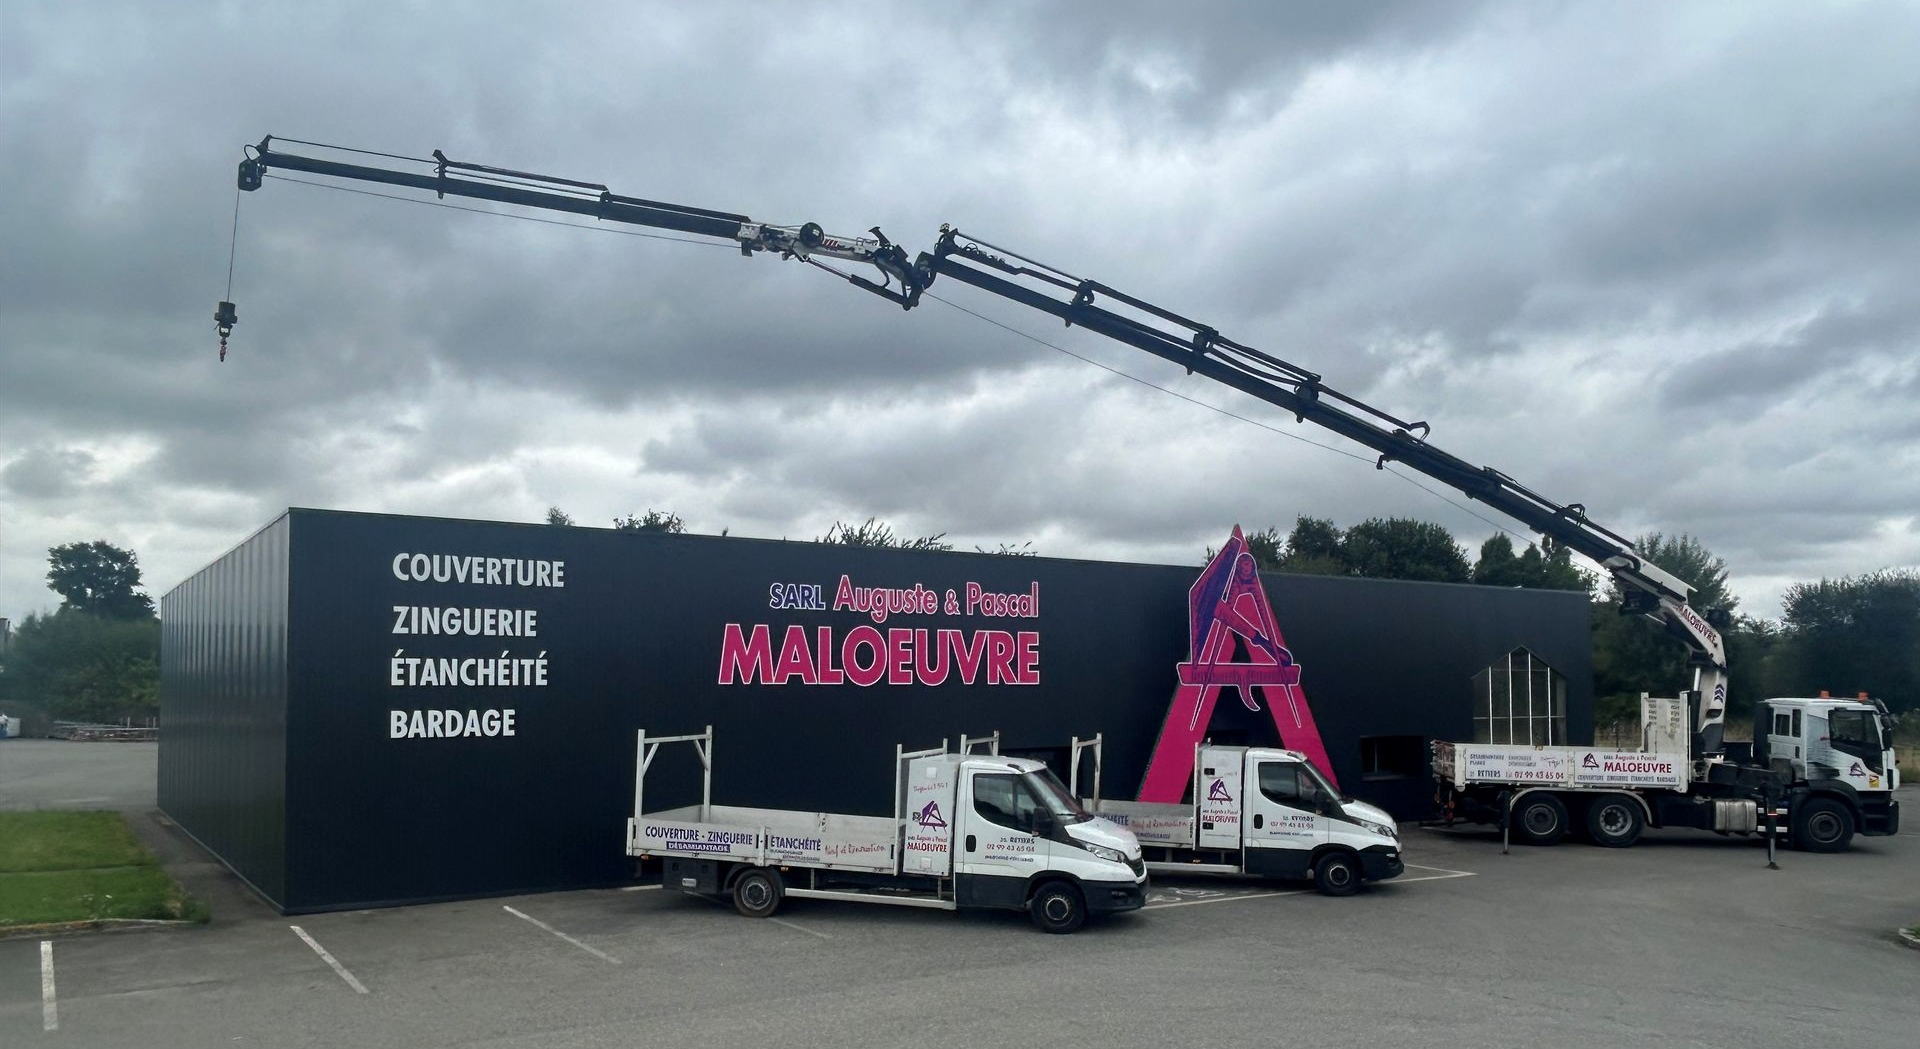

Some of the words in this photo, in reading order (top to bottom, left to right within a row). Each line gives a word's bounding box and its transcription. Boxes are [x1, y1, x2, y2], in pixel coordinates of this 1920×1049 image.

[392, 553, 564, 587] COUVERTURE
[769, 583, 825, 611] SARL
[833, 574, 937, 623] Auguste
[944, 589, 961, 615] &
[966, 581, 1039, 618] Pascal
[392, 605, 537, 637] ZINGUERIE
[391, 648, 548, 686] ÉTANCHÉITÉ
[718, 623, 1040, 686] MALOEUVRE
[390, 709, 516, 738] BARDAGE
[1604, 762, 1672, 773] MALOEUVRE
[645, 826, 699, 841] COUVERTURE
[707, 831, 753, 845] ZINGUERIE
